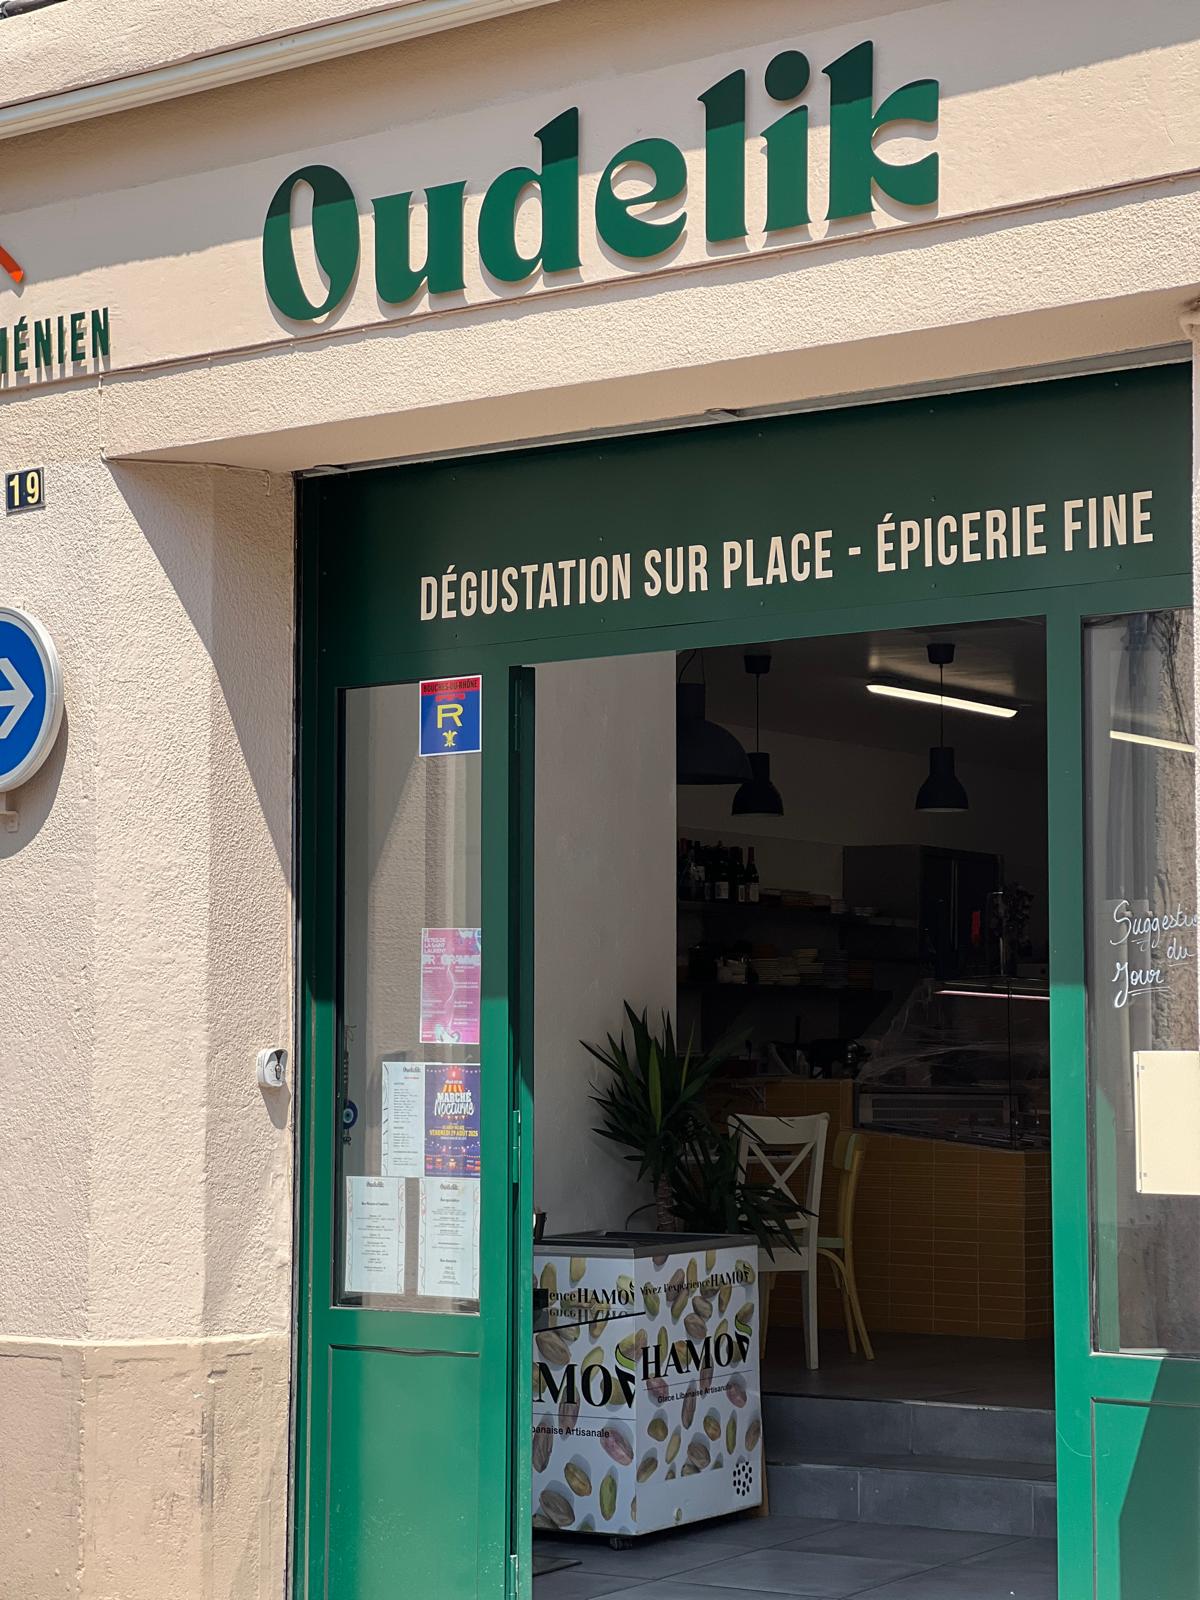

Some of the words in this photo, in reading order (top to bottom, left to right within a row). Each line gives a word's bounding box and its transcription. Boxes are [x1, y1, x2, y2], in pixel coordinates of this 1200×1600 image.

[262, 40, 939, 322] Oudelik
[9, 471, 40, 507] 19
[420, 553, 631, 621] DÉGUSTATION
[644, 544, 708, 597] SUR
[723, 530, 833, 589] PLACE
[848, 546, 861, 556] -
[877, 504, 1047, 572] ÉPICERIE
[1064, 490, 1153, 551] FINE
[437, 703, 464, 729] R
[1167, 937, 1193, 960] du
[437, 1090, 472, 1103] MARCHÉ
[565, 1427, 610, 1438] Artisanale
